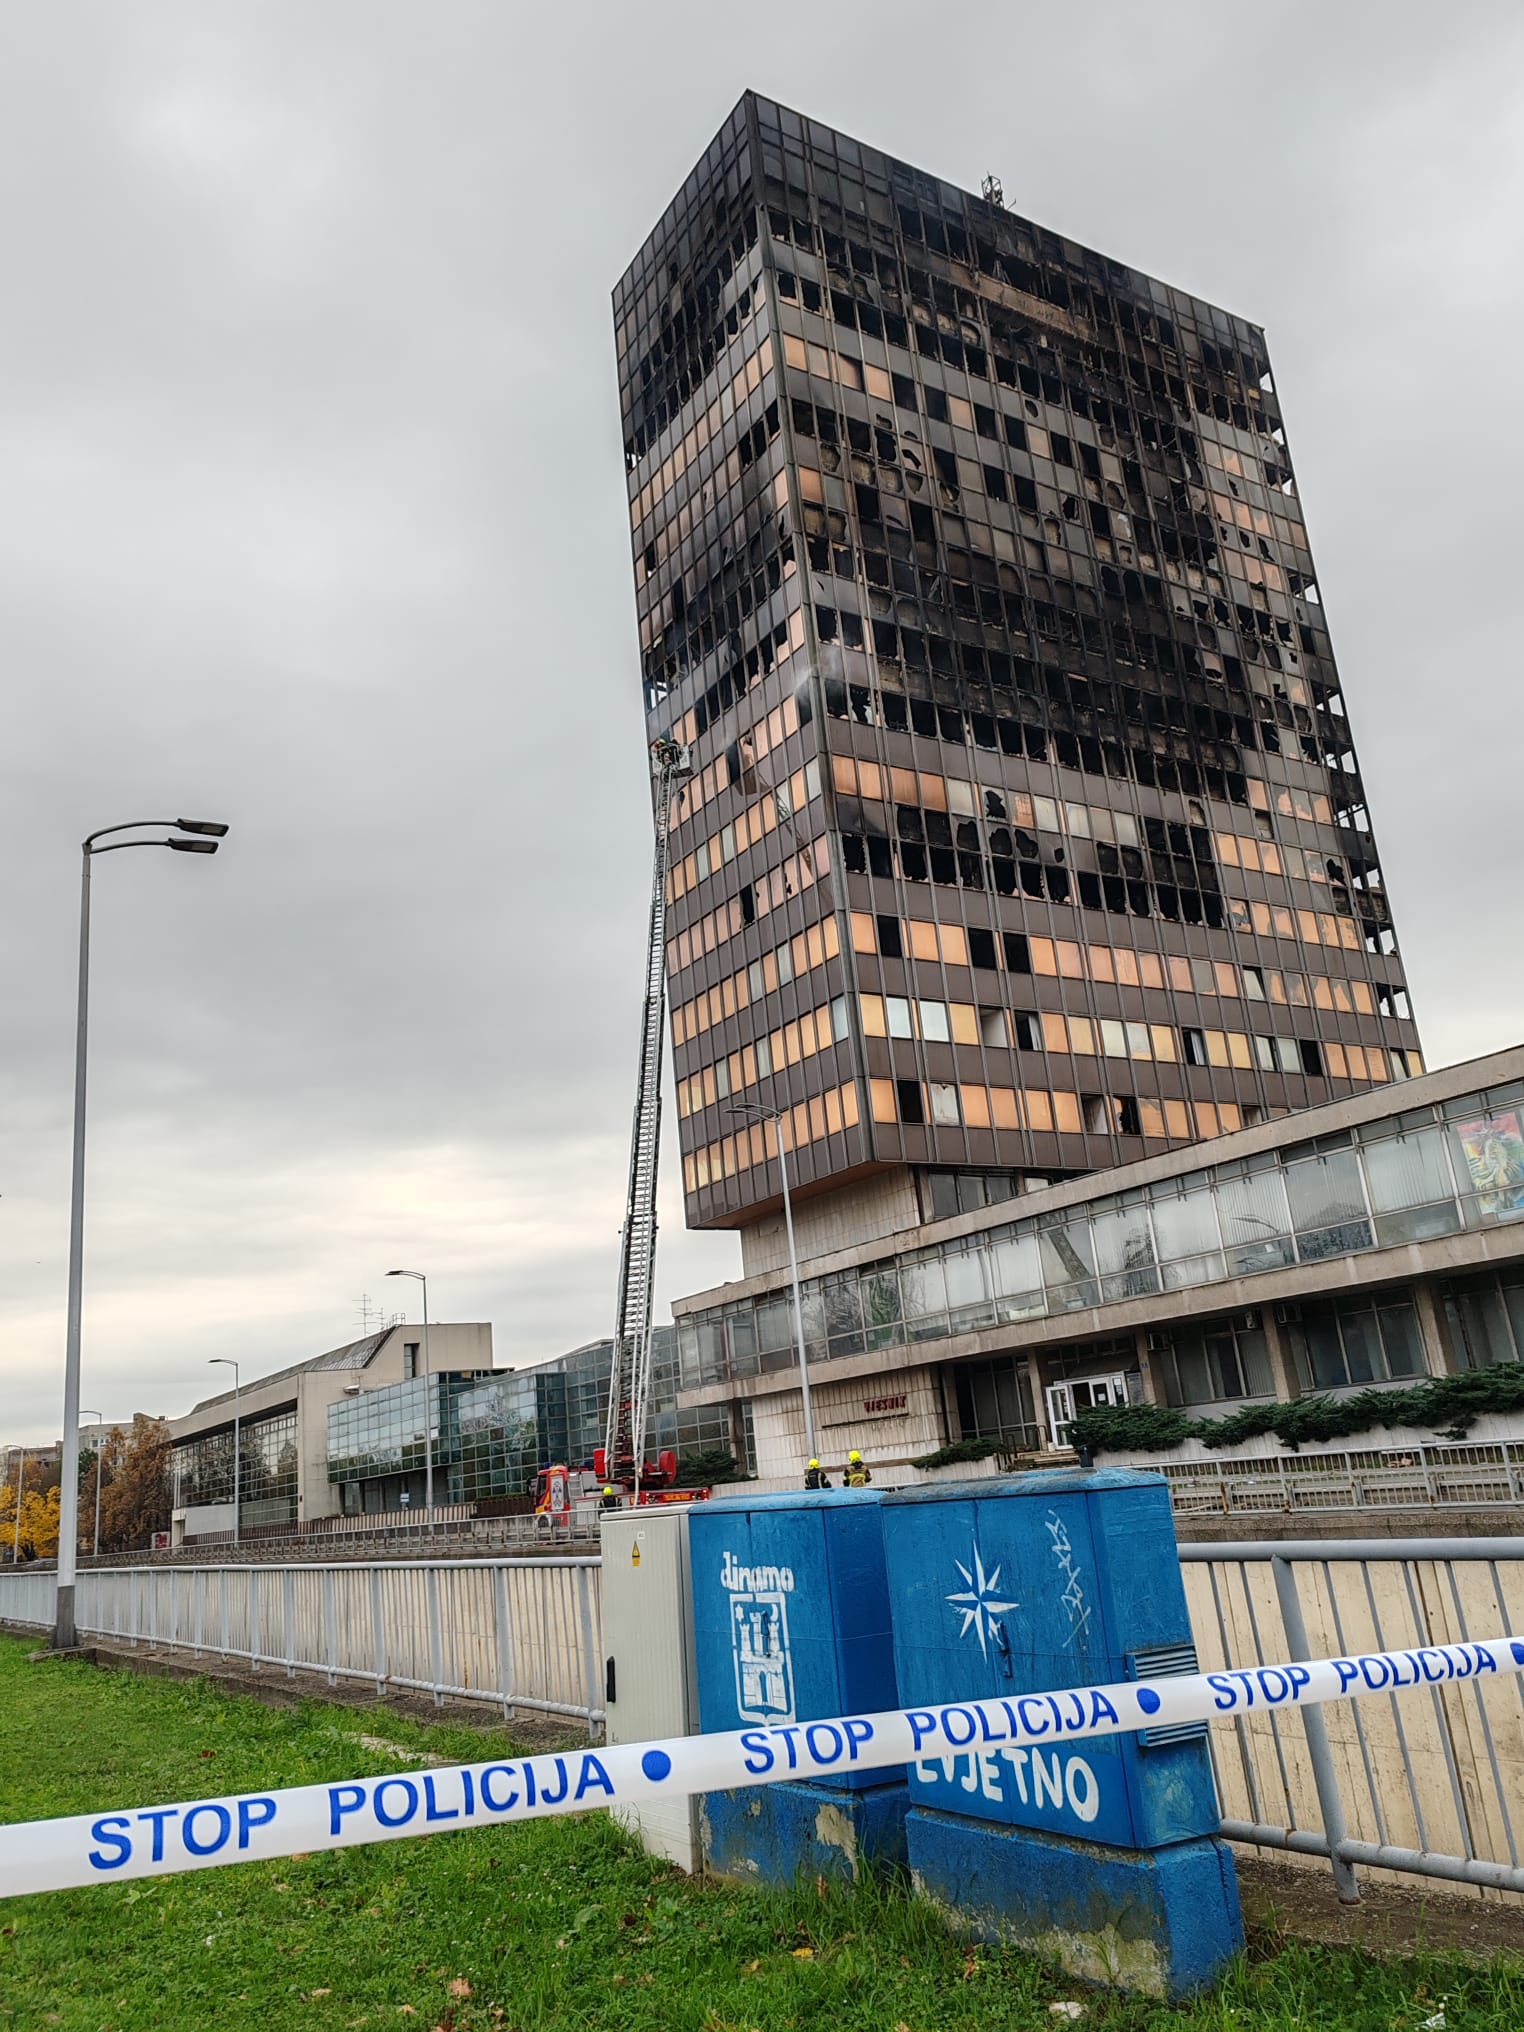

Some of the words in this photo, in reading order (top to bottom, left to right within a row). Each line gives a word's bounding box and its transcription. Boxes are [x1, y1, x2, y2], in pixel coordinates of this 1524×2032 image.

[720, 1551, 795, 1592] dinamo
[1206, 1667, 1311, 1710] STOP
[1330, 1644, 1497, 1694] POLICIJA
[740, 1720, 874, 1774] STOP
[906, 1690, 1119, 1751] POLICIJA
[88, 1798, 277, 1870] STOP
[329, 1754, 615, 1836] POLICIJA
